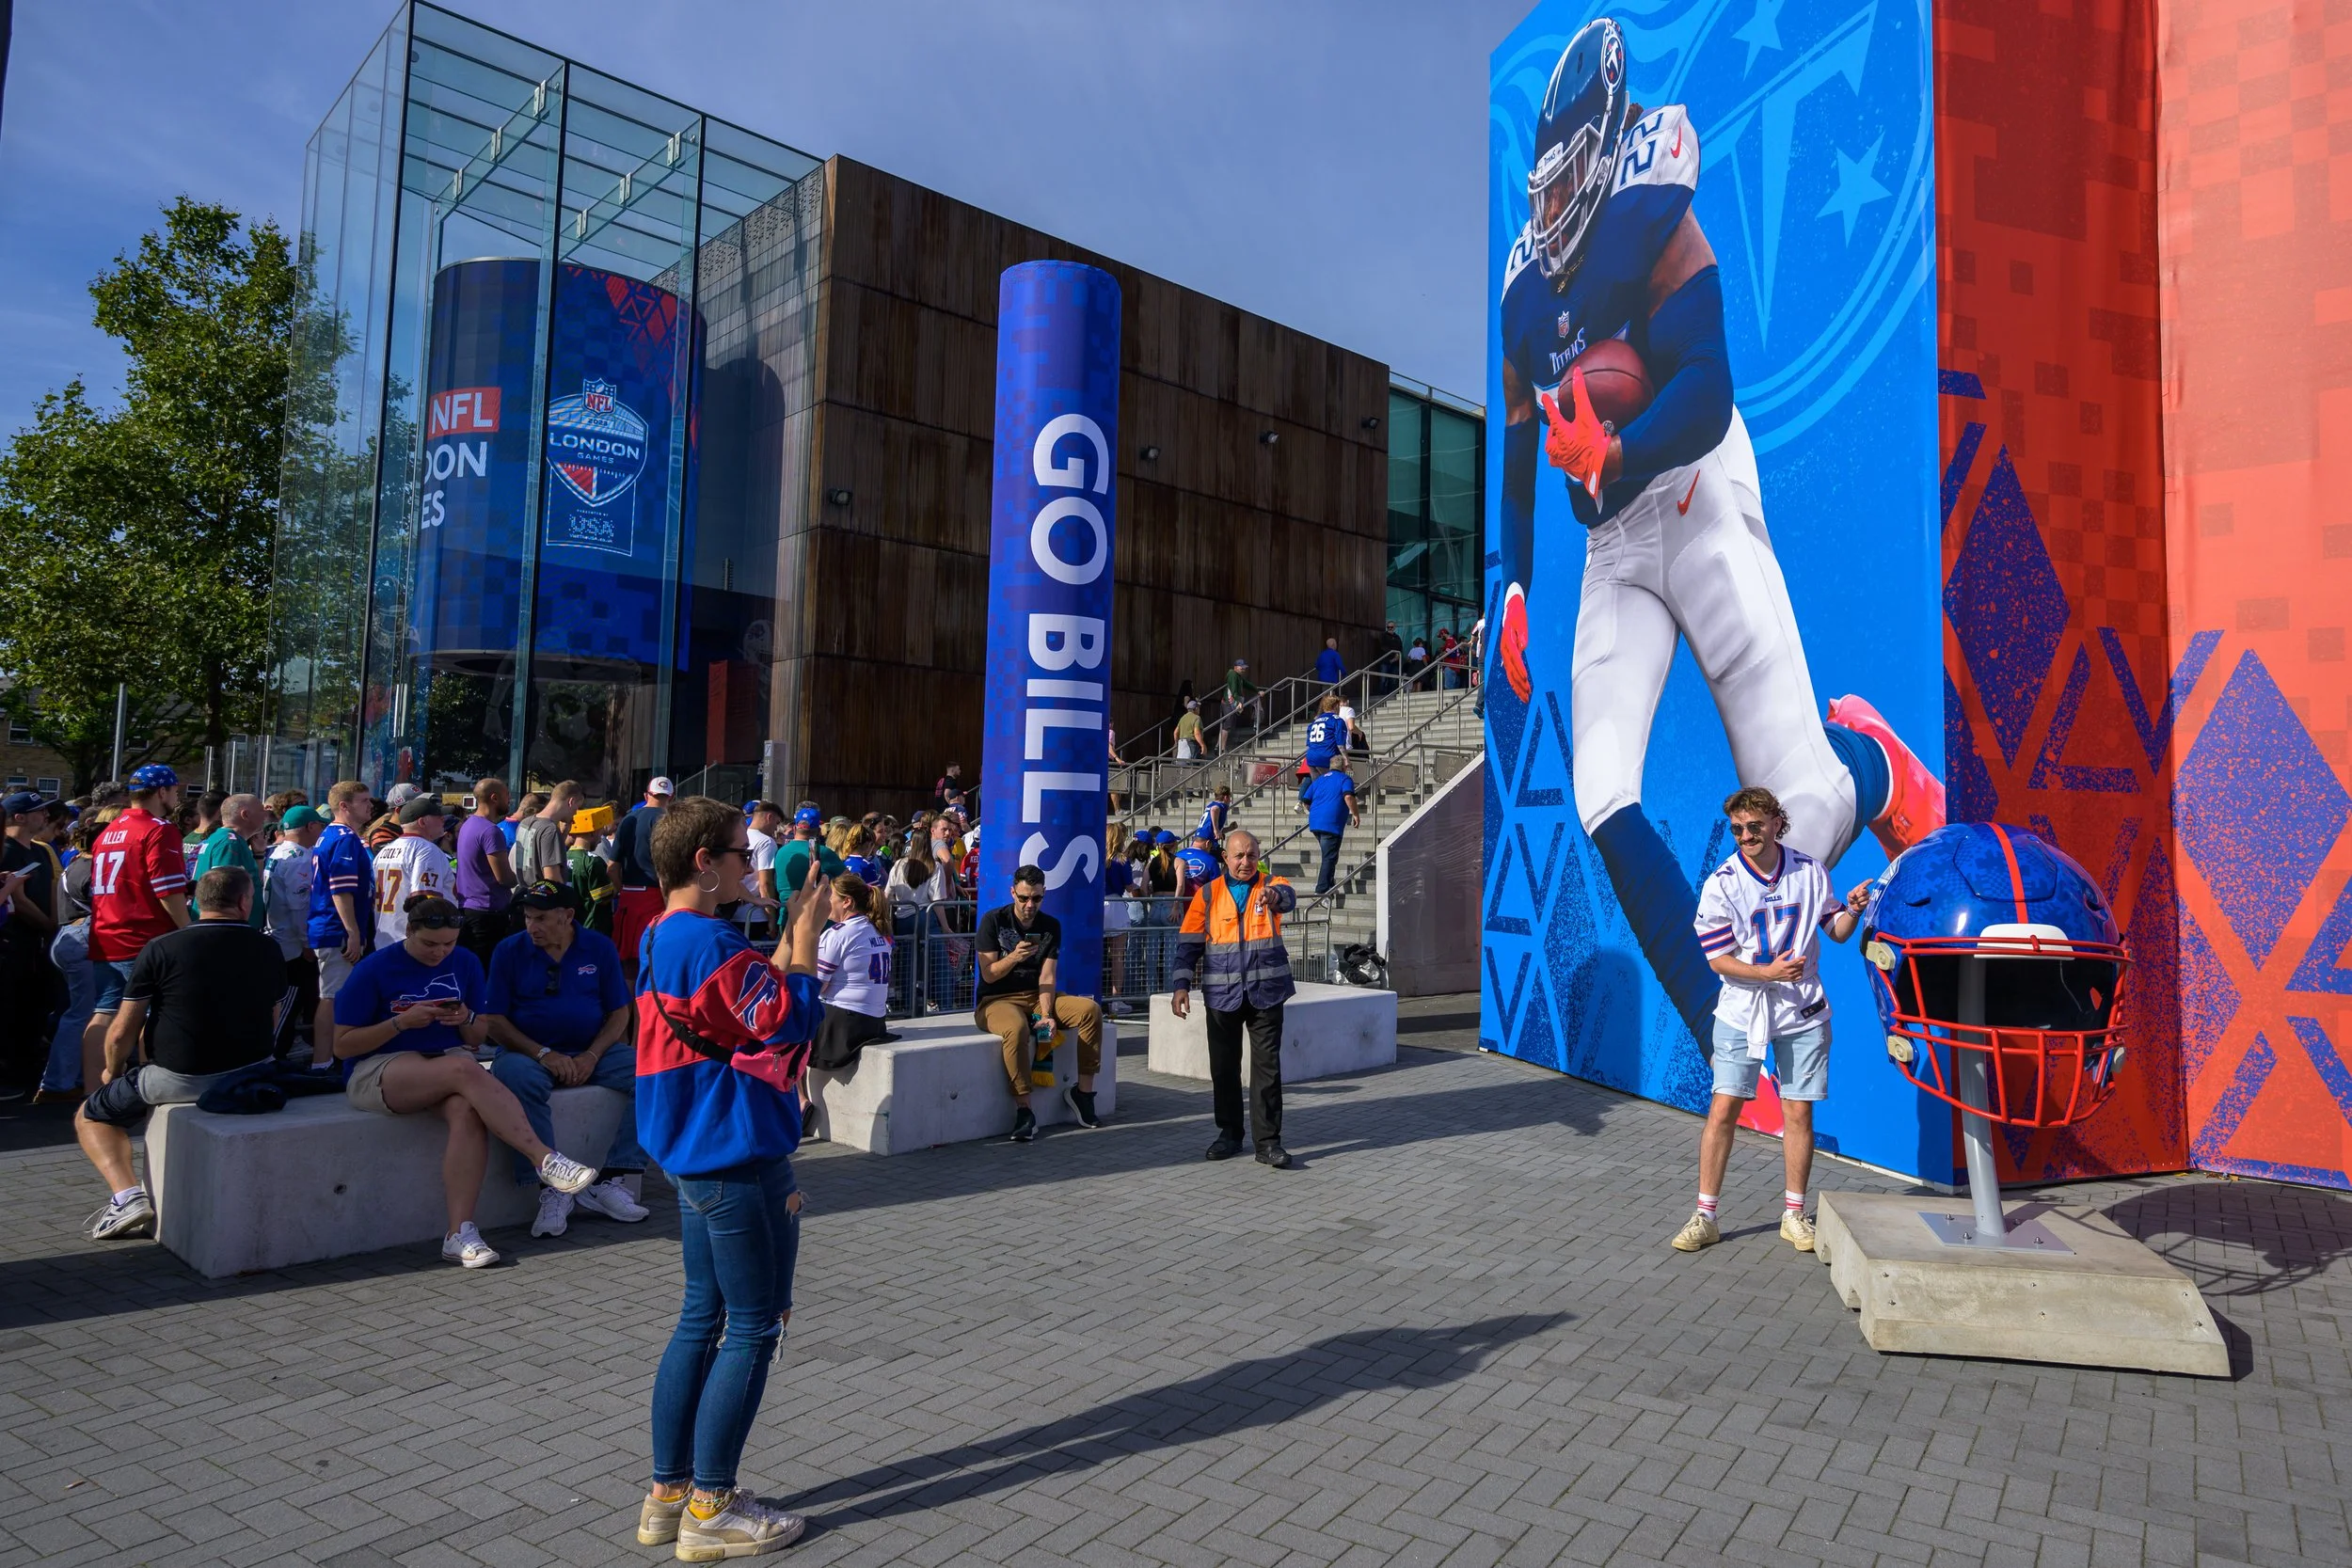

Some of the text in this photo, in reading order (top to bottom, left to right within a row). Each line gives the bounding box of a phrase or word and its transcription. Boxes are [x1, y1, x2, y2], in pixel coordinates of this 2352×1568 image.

[431, 391, 493, 435] NFL
[586, 394, 612, 411] NFL
[549, 432, 640, 460] LONDON
[577, 451, 614, 464] GAMES
[1019, 413, 1110, 892] GO BILLS
[1309, 722, 1326, 743] 26
[102, 830, 128, 845] ALLEN
[93, 850, 125, 895] 17
[421, 872, 438, 888] 47
[1764, 895, 1783, 903] BILLS
[1750, 902, 1802, 966] 17
